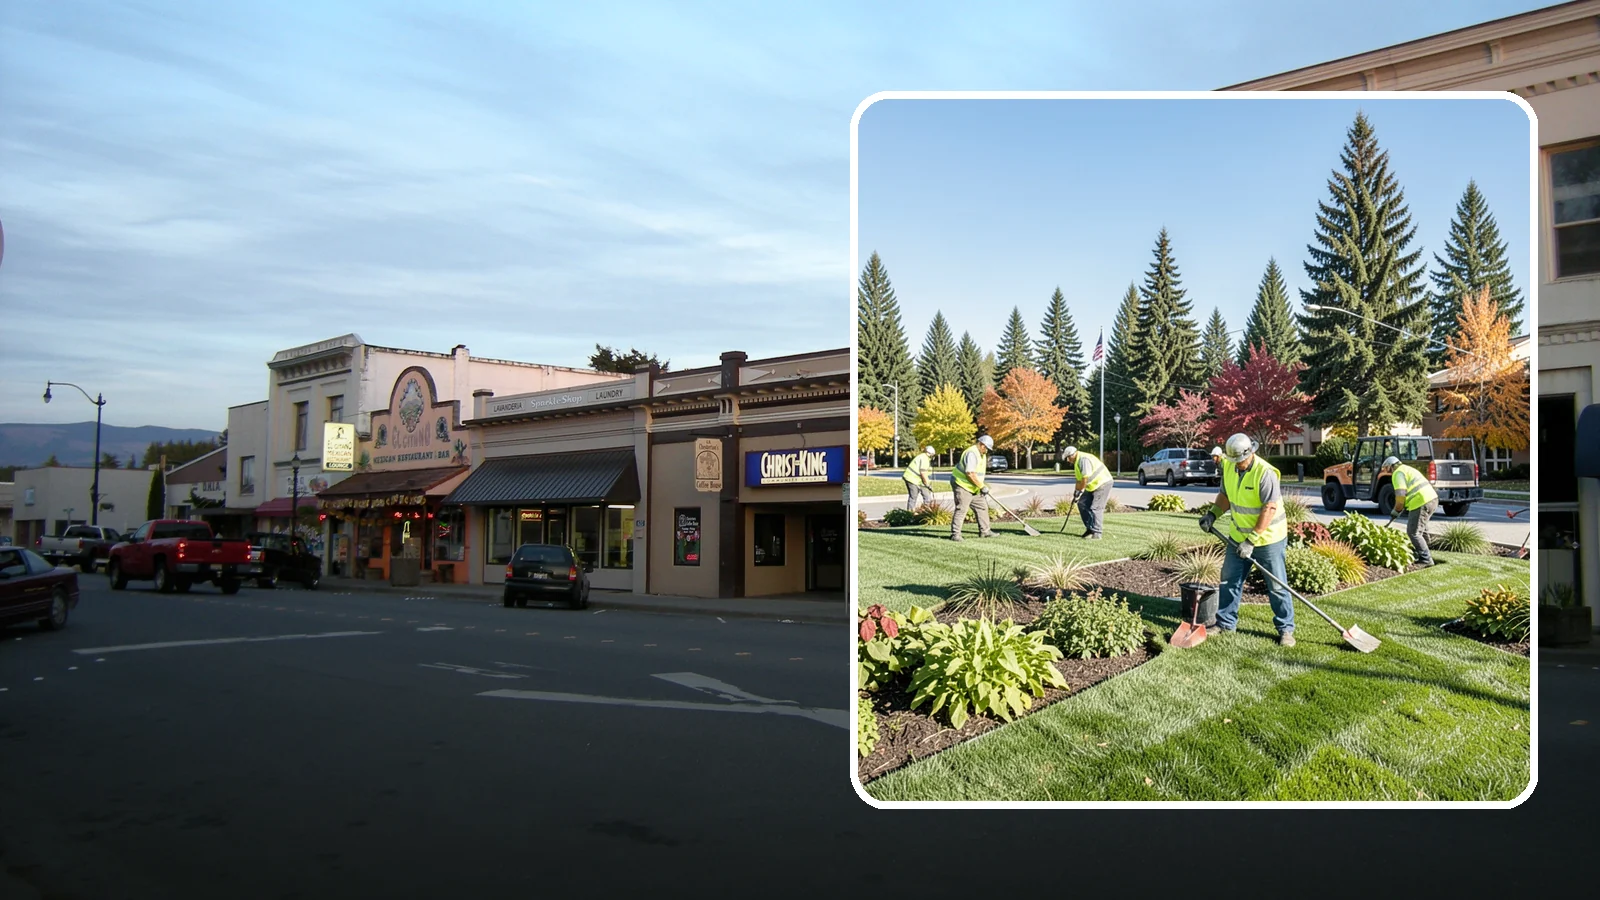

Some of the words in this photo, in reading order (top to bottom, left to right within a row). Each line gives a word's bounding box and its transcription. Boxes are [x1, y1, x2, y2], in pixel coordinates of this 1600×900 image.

[595, 388, 624, 400] LAUNDRY
[493, 401, 523, 413] LAVANDERIA
[530, 396, 561, 409] Sparkle
[562, 394, 582, 405] Shop
[373, 454, 397, 464] MEXICAN
[397, 451, 434, 462] RESTAURANT
[437, 450, 450, 459] BAR
[760, 451, 797, 478] CHRIST
[799, 449, 828, 476] KING
